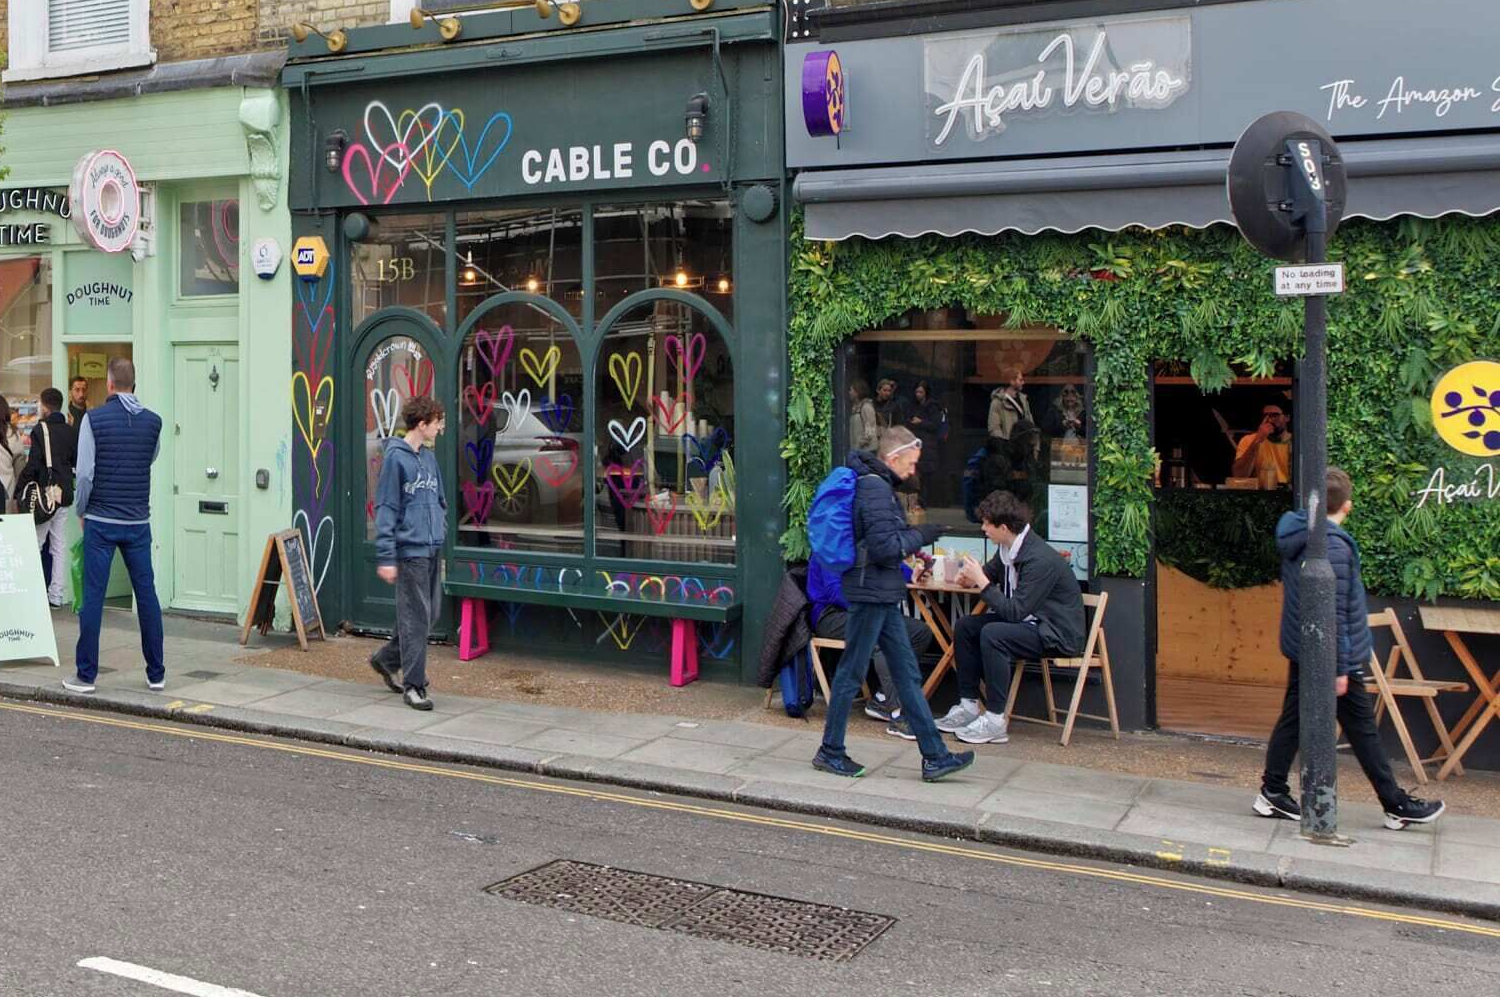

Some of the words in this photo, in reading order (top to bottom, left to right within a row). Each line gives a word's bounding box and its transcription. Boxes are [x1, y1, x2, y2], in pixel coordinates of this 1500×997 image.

[934, 53, 1051, 145] Açaí
[1038, 31, 1182, 107] Verão
[1319, 79, 1368, 121] The
[1376, 76, 1483, 119] Amazon
[521, 142, 633, 185] CABLE
[90, 209, 102, 228] FOR
[100, 212, 130, 239] DOUGHNUTS
[298, 250, 313, 262] ADT
[377, 257, 415, 283] 15B
[1282, 271, 1296, 279] No
[66, 282, 133, 305] DOUGHNUT
[1281, 282, 1290, 290] at
[1295, 282, 1312, 291] any
[1316, 280, 1337, 289] time
[89, 297, 110, 306] TIME
[1417, 467, 1481, 508] Açaí
[11, 555, 24, 568] IN
